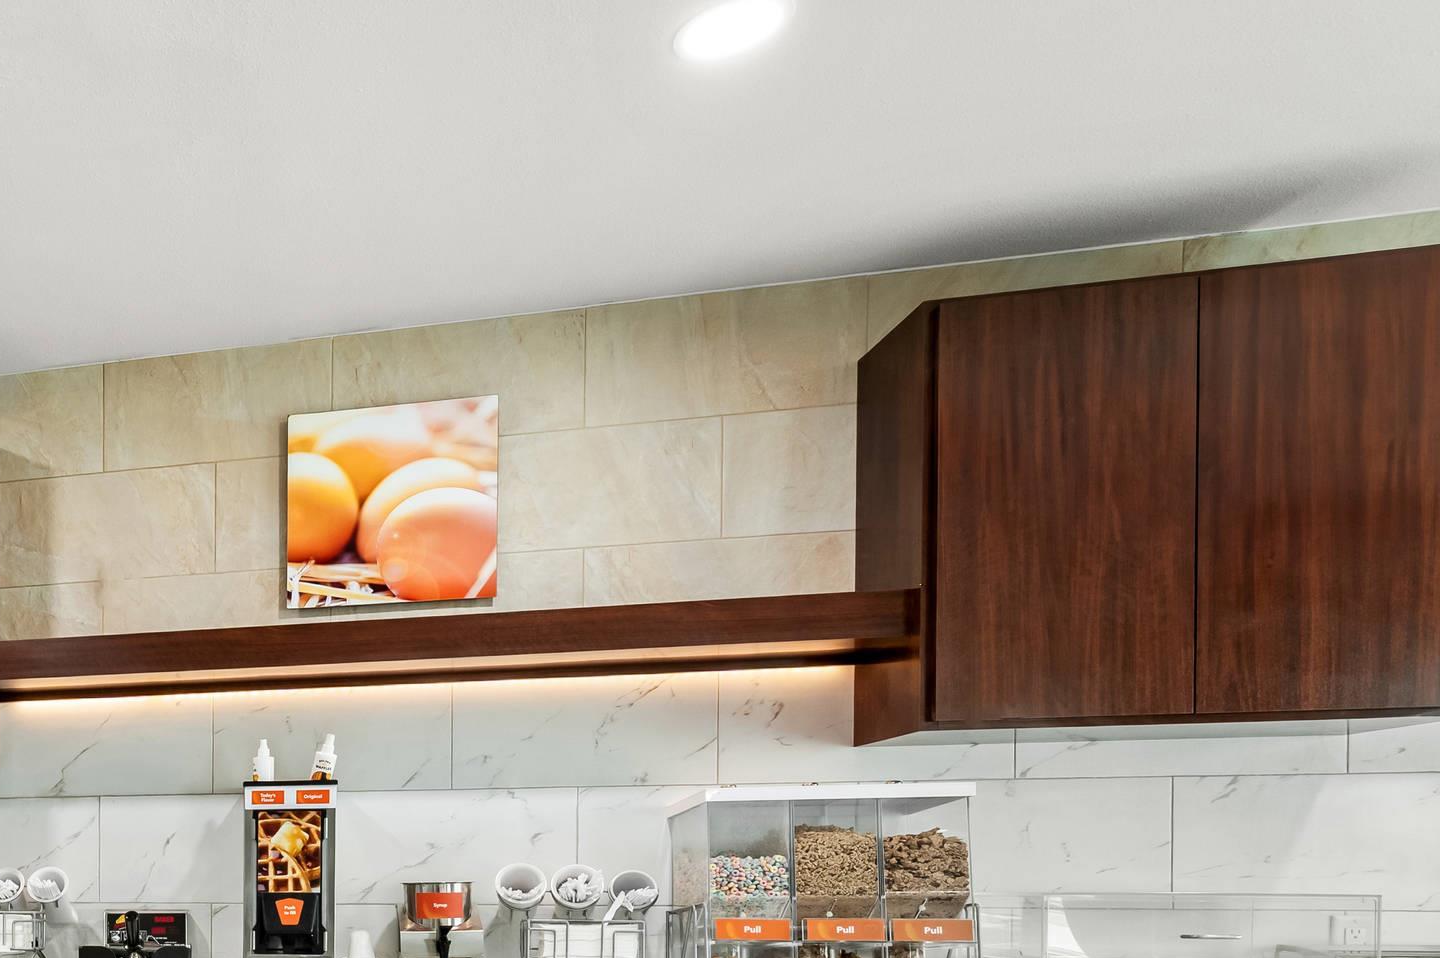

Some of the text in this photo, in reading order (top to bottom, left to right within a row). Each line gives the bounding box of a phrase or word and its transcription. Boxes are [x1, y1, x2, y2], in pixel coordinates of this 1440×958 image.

[743, 925, 762, 934] Pull
[836, 925, 855, 934] Pull
[923, 926, 943, 935] Pull
